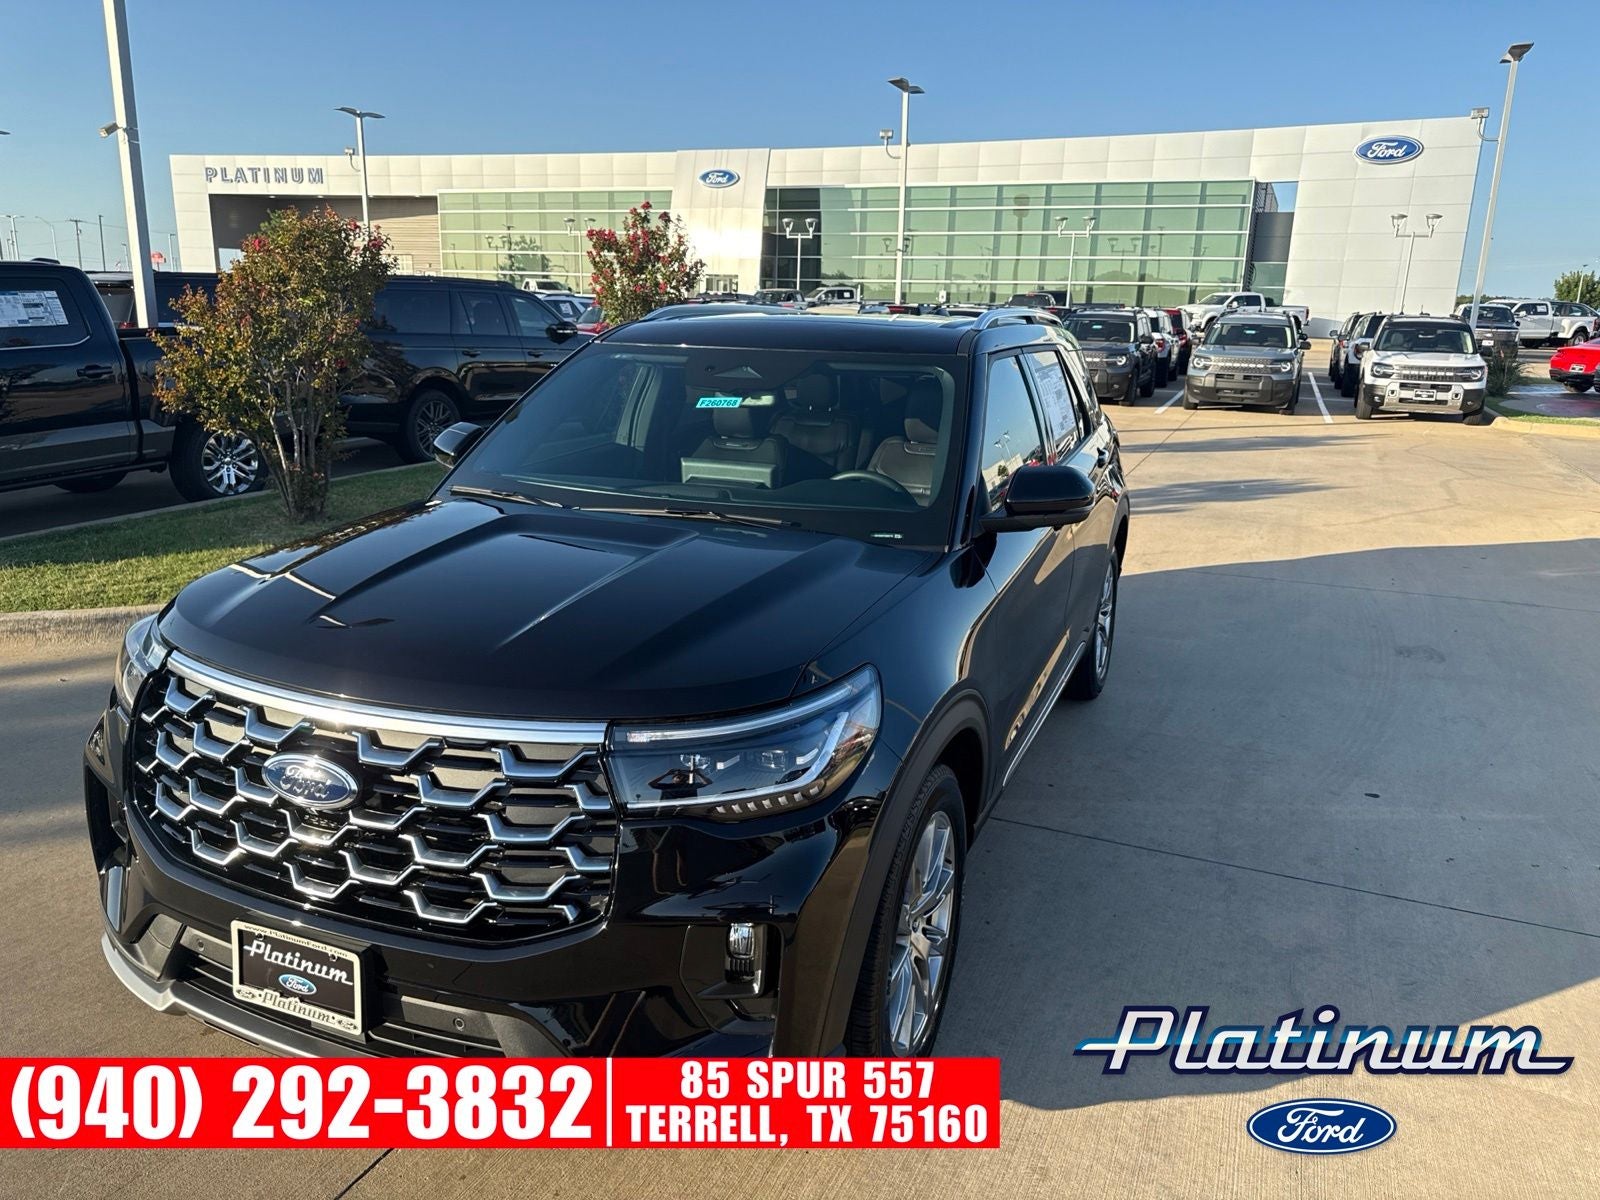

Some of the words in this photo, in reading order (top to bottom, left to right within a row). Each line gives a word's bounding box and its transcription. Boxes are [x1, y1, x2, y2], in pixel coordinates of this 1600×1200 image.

[1367, 141, 1408, 158] Ford
[204, 166, 324, 184] PLATINUM
[699, 399, 738, 407] F260768
[243, 939, 353, 986] Platinum
[285, 976, 309, 993] Ford
[262, 989, 336, 1025] Platinum
